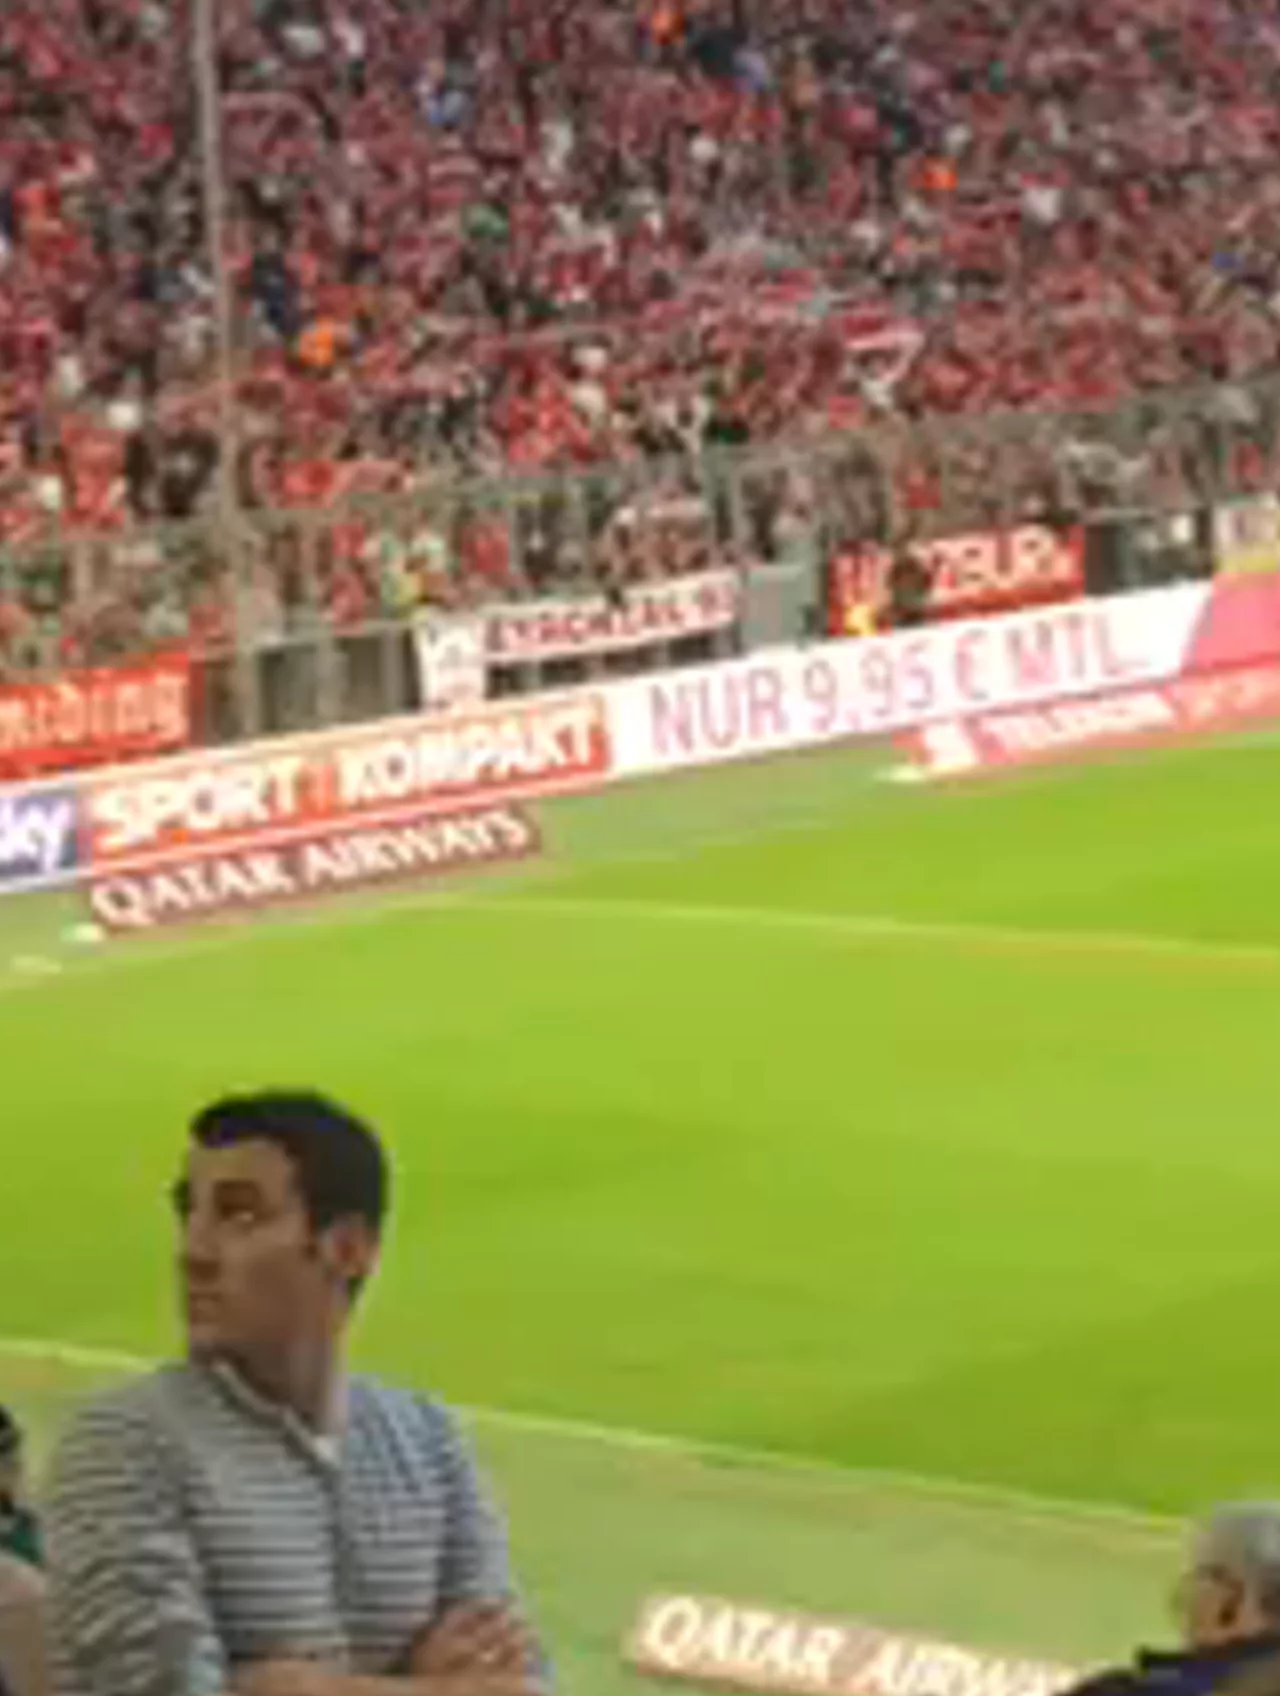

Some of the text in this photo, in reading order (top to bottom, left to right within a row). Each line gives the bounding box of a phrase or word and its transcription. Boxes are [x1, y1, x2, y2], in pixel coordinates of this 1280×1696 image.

[94, 756, 308, 848] SPORT
[336, 710, 598, 802] KOMPAKT
[648, 666, 790, 756] NUR
[954, 628, 990, 702] €
[90, 808, 528, 926] QATAR AIRWAYS
[638, 1596, 844, 1680] QATAR
